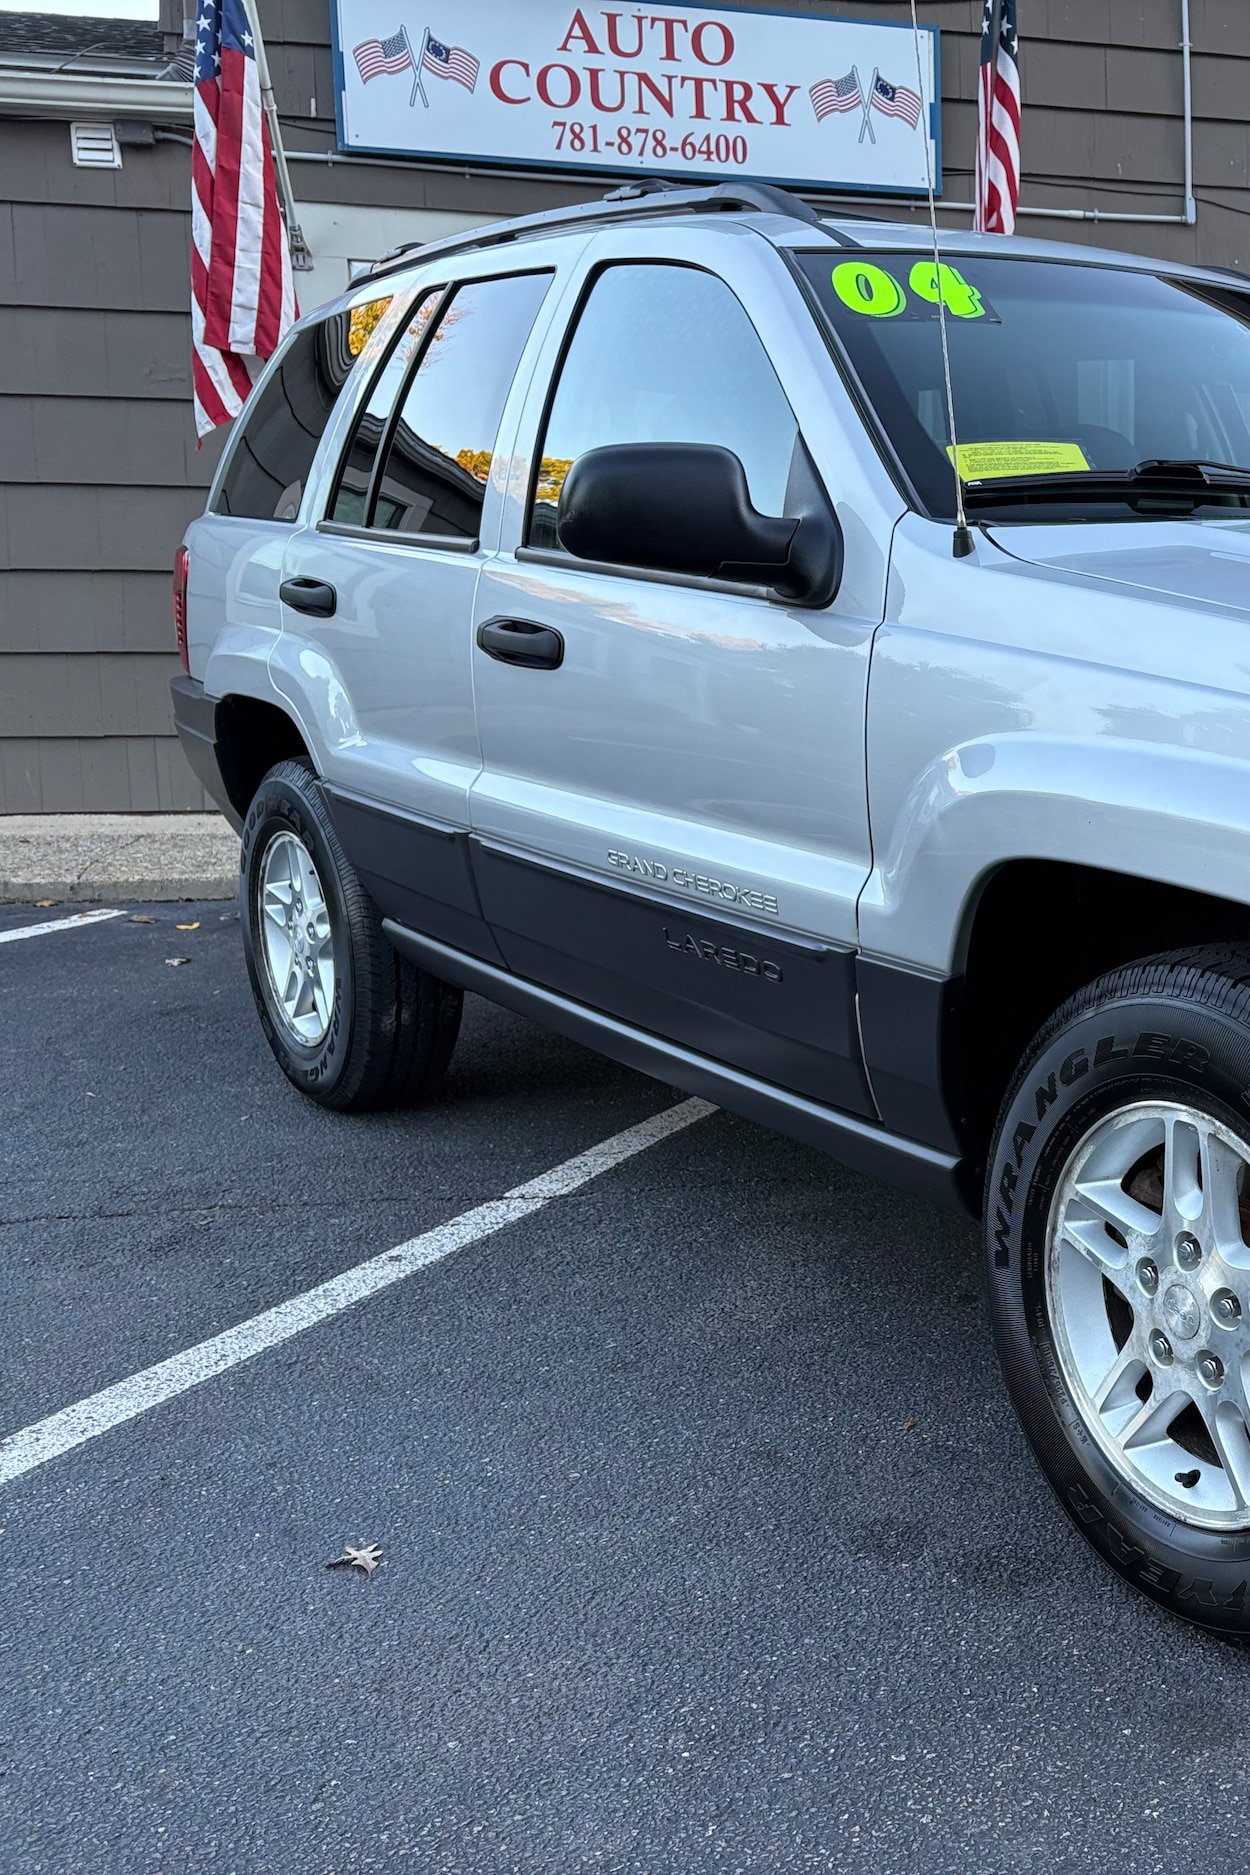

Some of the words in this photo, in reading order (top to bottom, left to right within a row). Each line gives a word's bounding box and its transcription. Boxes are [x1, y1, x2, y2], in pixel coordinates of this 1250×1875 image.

[557, 8, 736, 67] AUTO
[488, 59, 802, 127] COUNTRY
[551, 119, 749, 165] 781-878-6400
[831, 261, 987, 319] 04
[607, 849, 669, 881] GRAND
[672, 868, 779, 915] CHEROKEE
[662, 926, 784, 984] LAREDO
[994, 1031, 1211, 1268] WRANGLER
